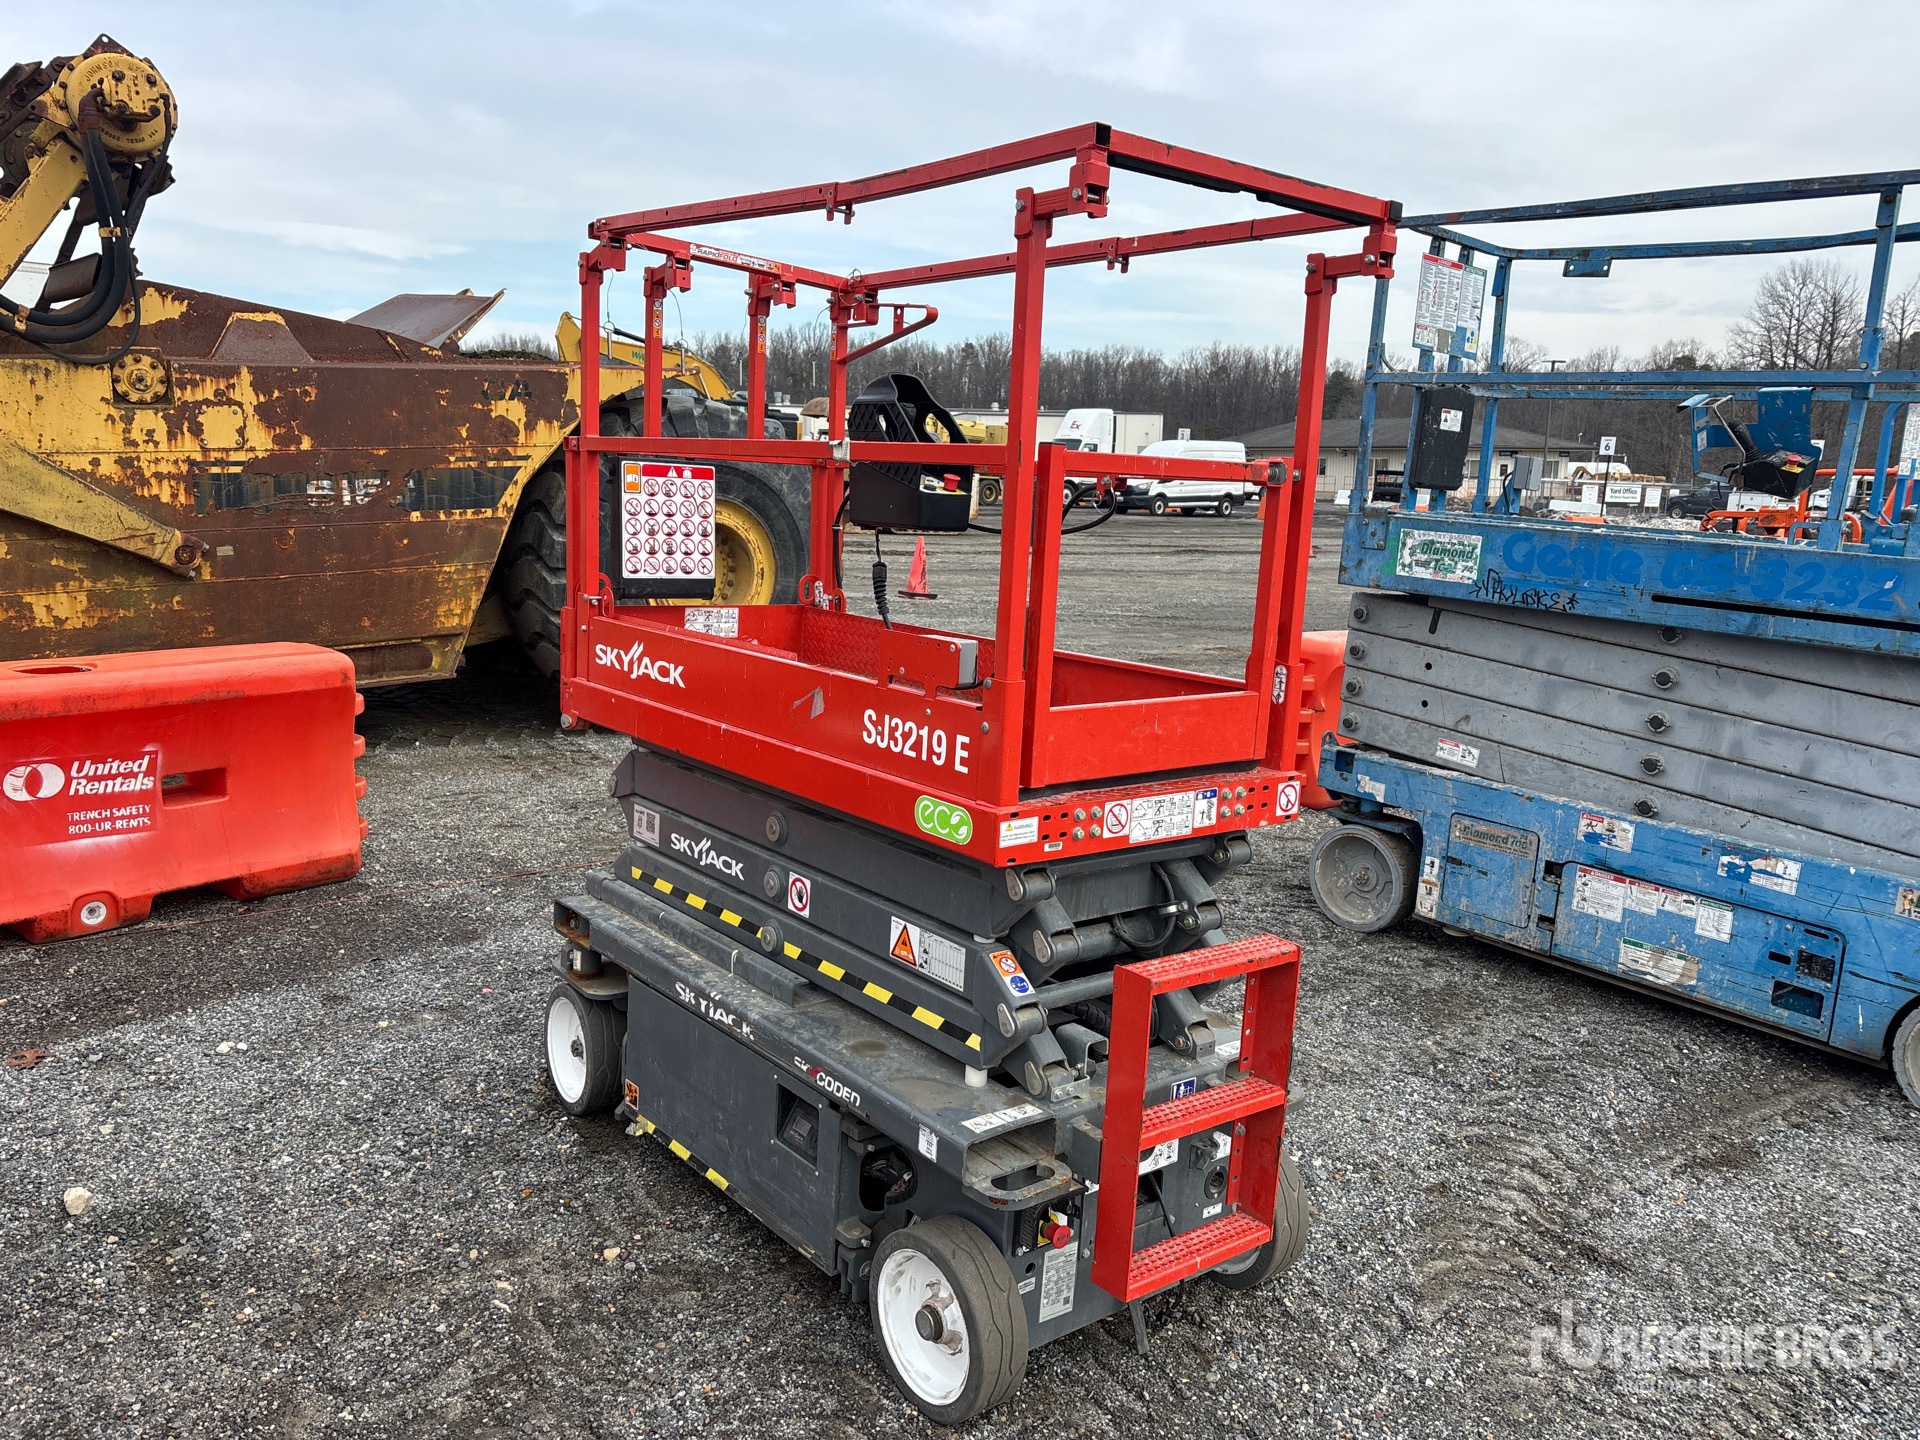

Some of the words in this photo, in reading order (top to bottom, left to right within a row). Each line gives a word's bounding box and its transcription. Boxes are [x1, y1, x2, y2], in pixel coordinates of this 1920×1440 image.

[84, 60, 119, 82] JOHNSON
[1604, 443, 1611, 451] 6
[1421, 542, 1475, 560] Diamond
[1502, 532, 1644, 585] Genie
[1660, 550, 1903, 611] GS-3232
[595, 640, 686, 688] SKYJACK
[862, 708, 948, 767] SJ3219
[954, 733, 970, 774] E
[69, 754, 150, 778] United
[69, 773, 155, 796] Rentals
[67, 809, 110, 822] TRENCH
[113, 804, 151, 817] SAFETY
[918, 800, 968, 839] eco
[68, 817, 151, 835] 800-UR-RENTS
[670, 833, 744, 881] SKYJACK
[1595, 871, 1614, 880] DANGER
[1642, 944, 1678, 959] INSTRUCTIONS
